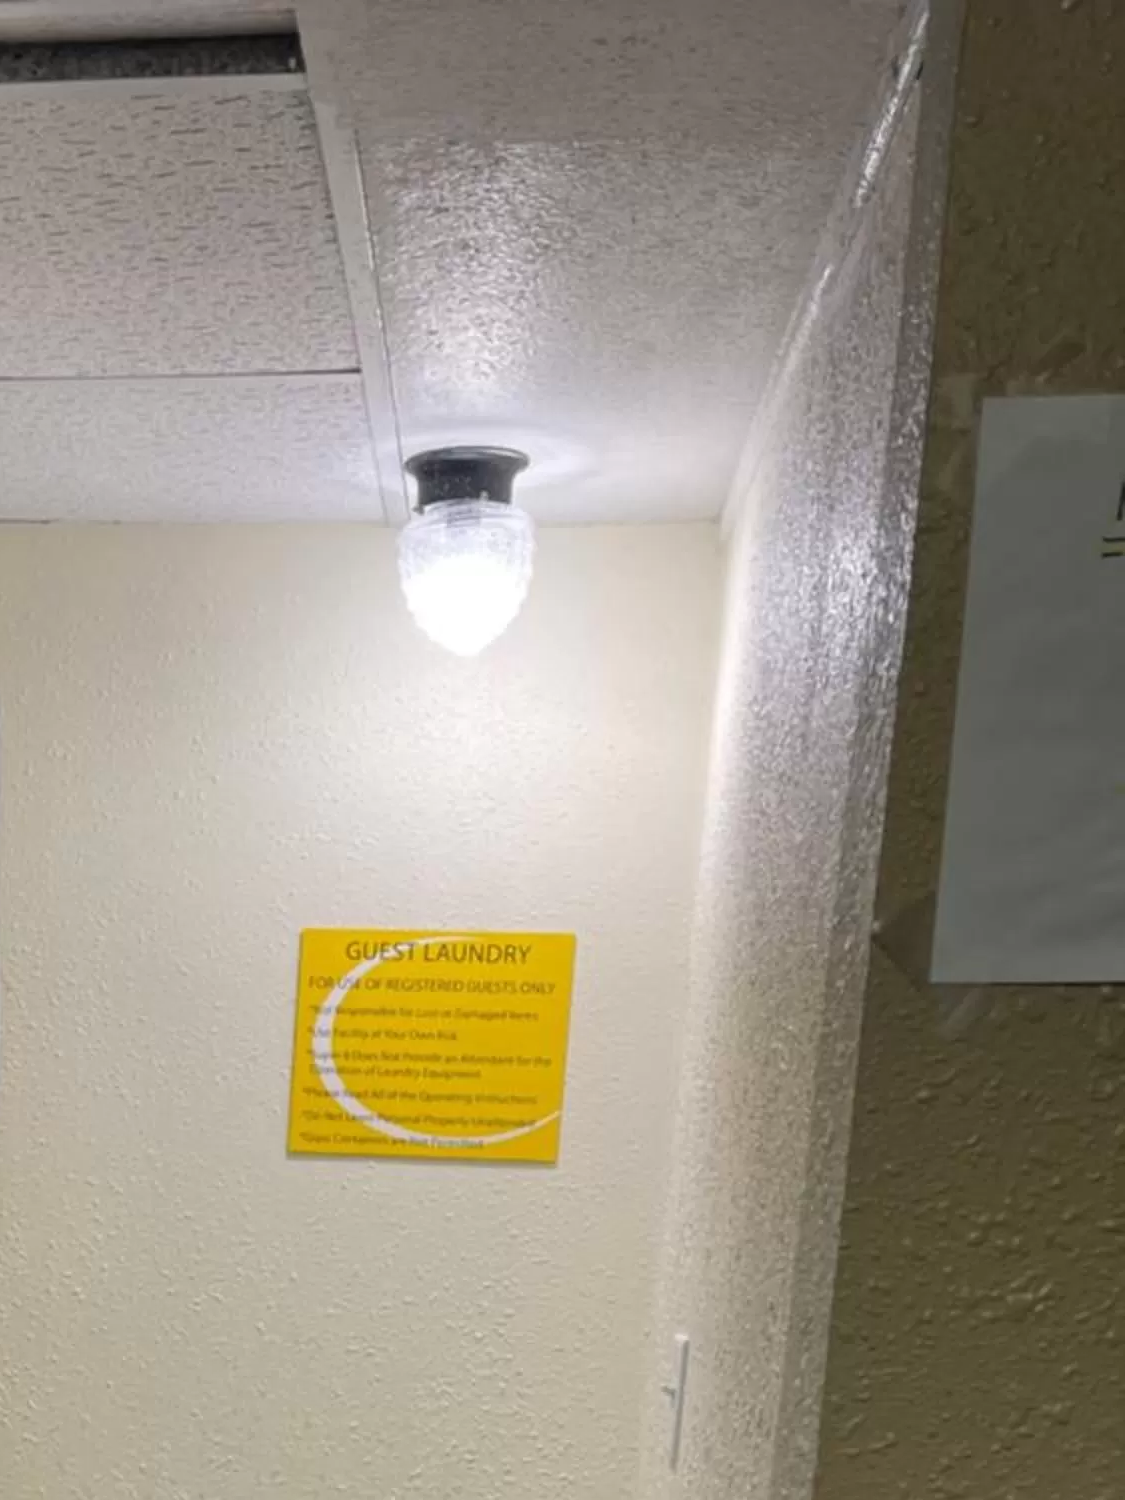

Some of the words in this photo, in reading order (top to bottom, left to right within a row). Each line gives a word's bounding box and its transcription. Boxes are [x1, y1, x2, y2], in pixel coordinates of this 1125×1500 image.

[346, 941, 414, 961] GUEST
[424, 942, 531, 964] LAUNDRY
[308, 975, 334, 989] FOR
[365, 977, 381, 990] OF
[386, 977, 462, 992] REGISTERED
[467, 979, 517, 993] GUESTS
[521, 980, 555, 994] ONLY
